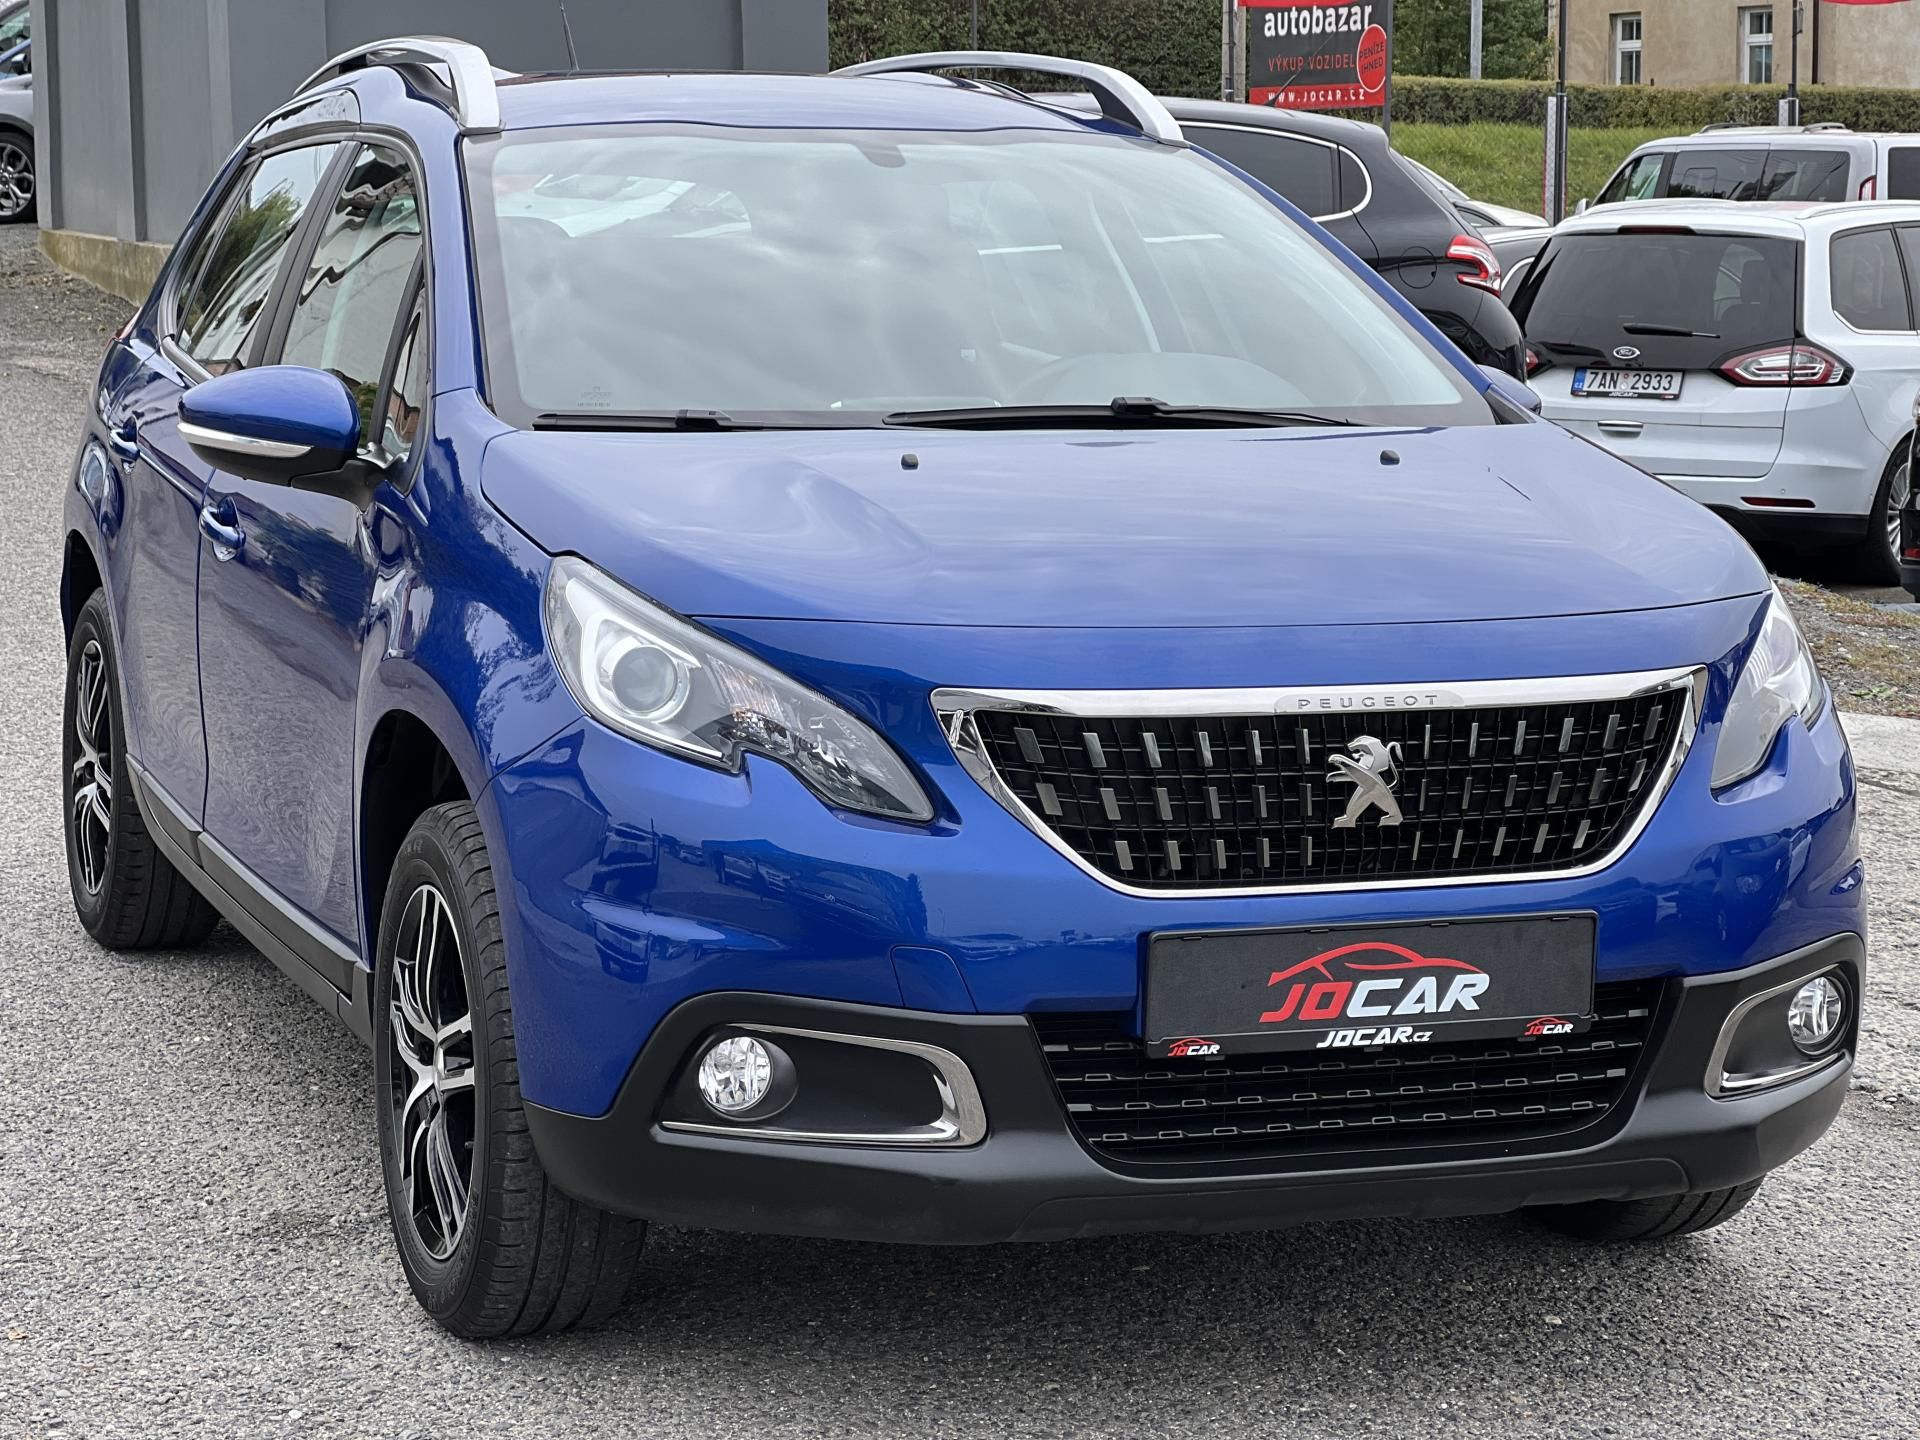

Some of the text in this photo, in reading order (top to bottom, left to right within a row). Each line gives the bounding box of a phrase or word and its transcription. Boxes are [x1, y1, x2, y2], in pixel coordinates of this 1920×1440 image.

[1264, 5, 1372, 37] autobazar
[1268, 54, 1355, 72] VÝKUP VOZIDEL
[1361, 58, 1384, 74] IHNED
[1587, 372, 1620, 389] 7AN
[1630, 373, 1674, 391] 2933
[1297, 694, 1438, 709] PEUGEOT
[1259, 973, 1490, 1023] JOCAR
[1524, 1023, 1574, 1036] JOCAR
[1167, 1044, 1220, 1056] JOCAR
